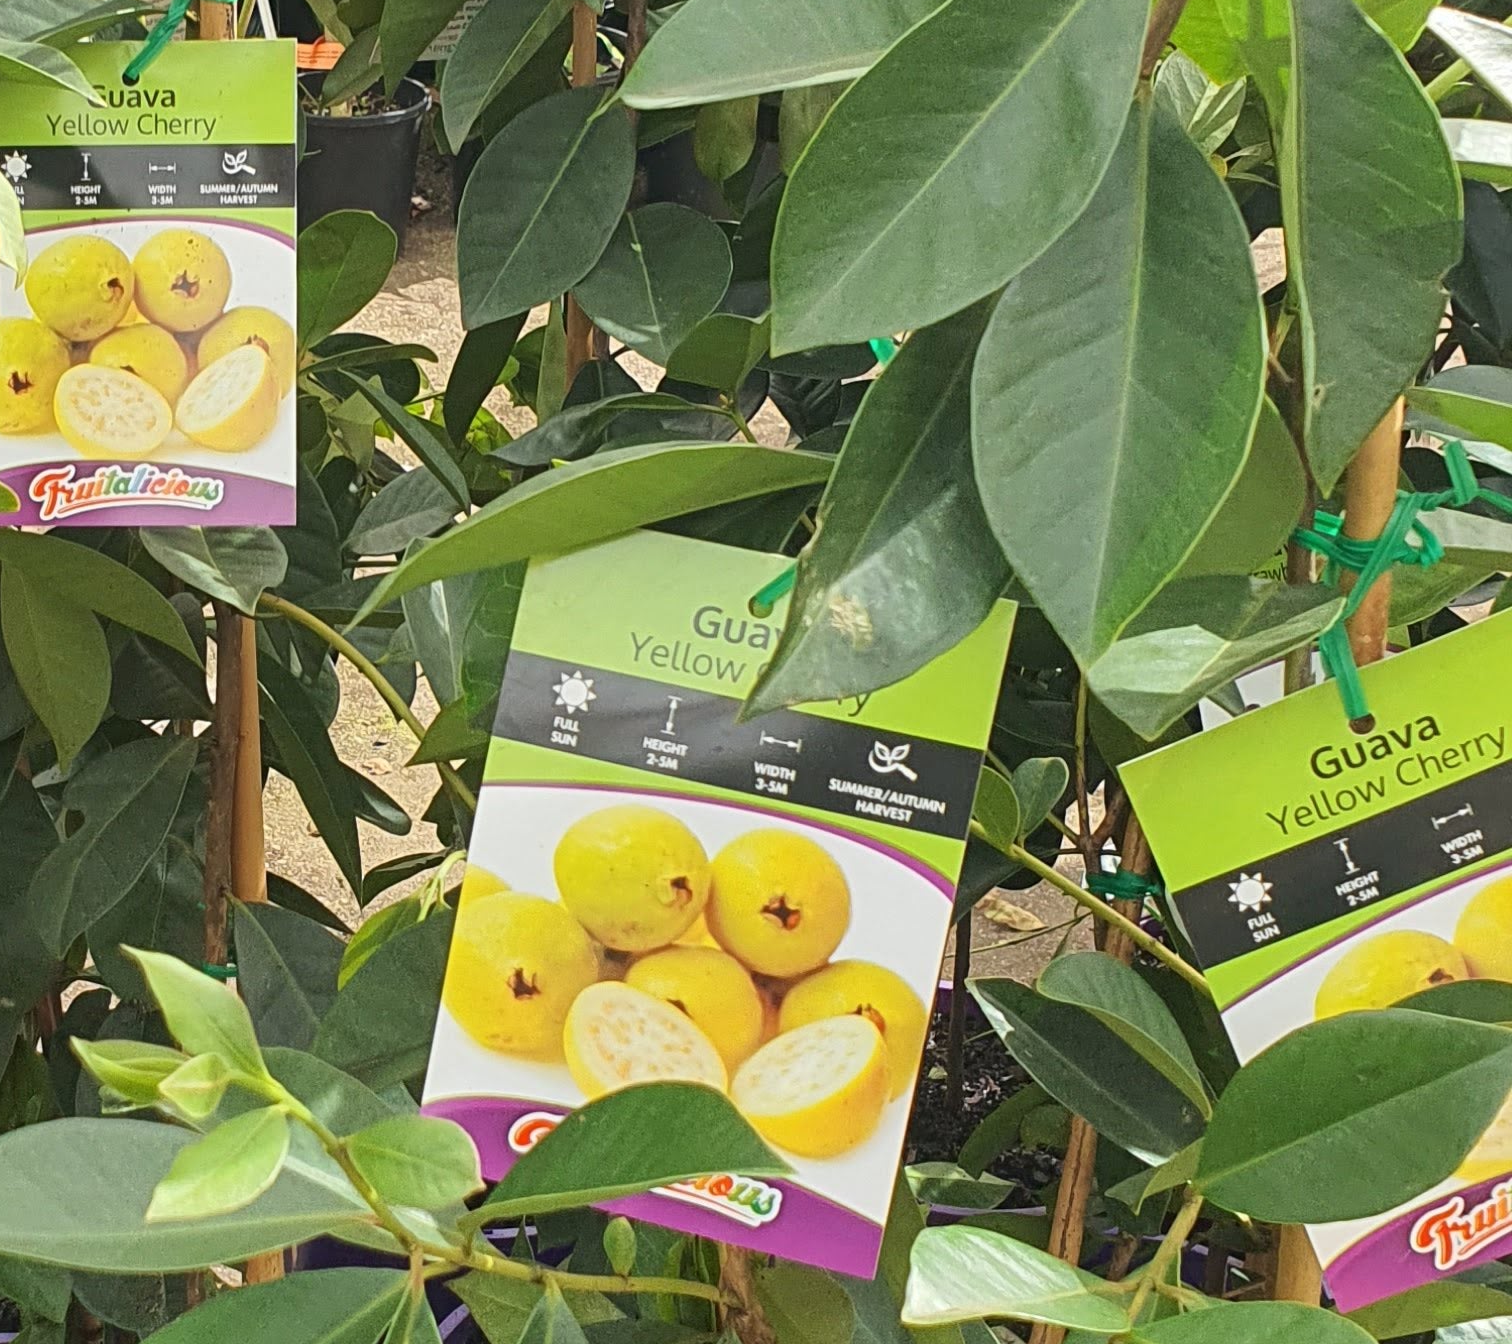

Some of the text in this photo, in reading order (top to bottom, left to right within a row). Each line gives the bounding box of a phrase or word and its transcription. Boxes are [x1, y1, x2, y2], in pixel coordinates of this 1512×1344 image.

[88, 85, 176, 109] Guava
[46, 113, 217, 141] Yellow Cherry
[70, 185, 101, 194] HEIGHT
[148, 184, 177, 194] WIDTH
[199, 183, 278, 194] SUMMER/AUTUMN
[75, 196, 98, 205] 2-5M
[151, 195, 174, 205] 3-5M
[219, 194, 258, 205] HARVEST
[32, 467, 221, 517] Fruitalicious
[693, 606, 783, 650] Gua
[630, 631, 747, 683] Yellow
[553, 716, 580, 733] FULL
[550, 730, 578, 747] SUN
[642, 736, 689, 757] HEIGHT
[1310, 715, 1441, 779] Guava
[646, 753, 679, 770] 2-5M
[753, 761, 797, 782] WIDTH
[755, 778, 788, 795] 3-5M
[1265, 726, 1506, 835] Yellow Cherry
[828, 778, 946, 815] SUMMER/AUTUMN
[855, 799, 913, 823] HARVEST
[1440, 829, 1483, 855] WIDTH
[1450, 844, 1484, 865] 3-5M
[1335, 870, 1380, 897] HEIGHT
[1346, 886, 1379, 907] 2-5M
[1247, 911, 1276, 931] FULL
[1252, 924, 1281, 944] SUN
[1416, 1184, 1512, 1266] Frui
